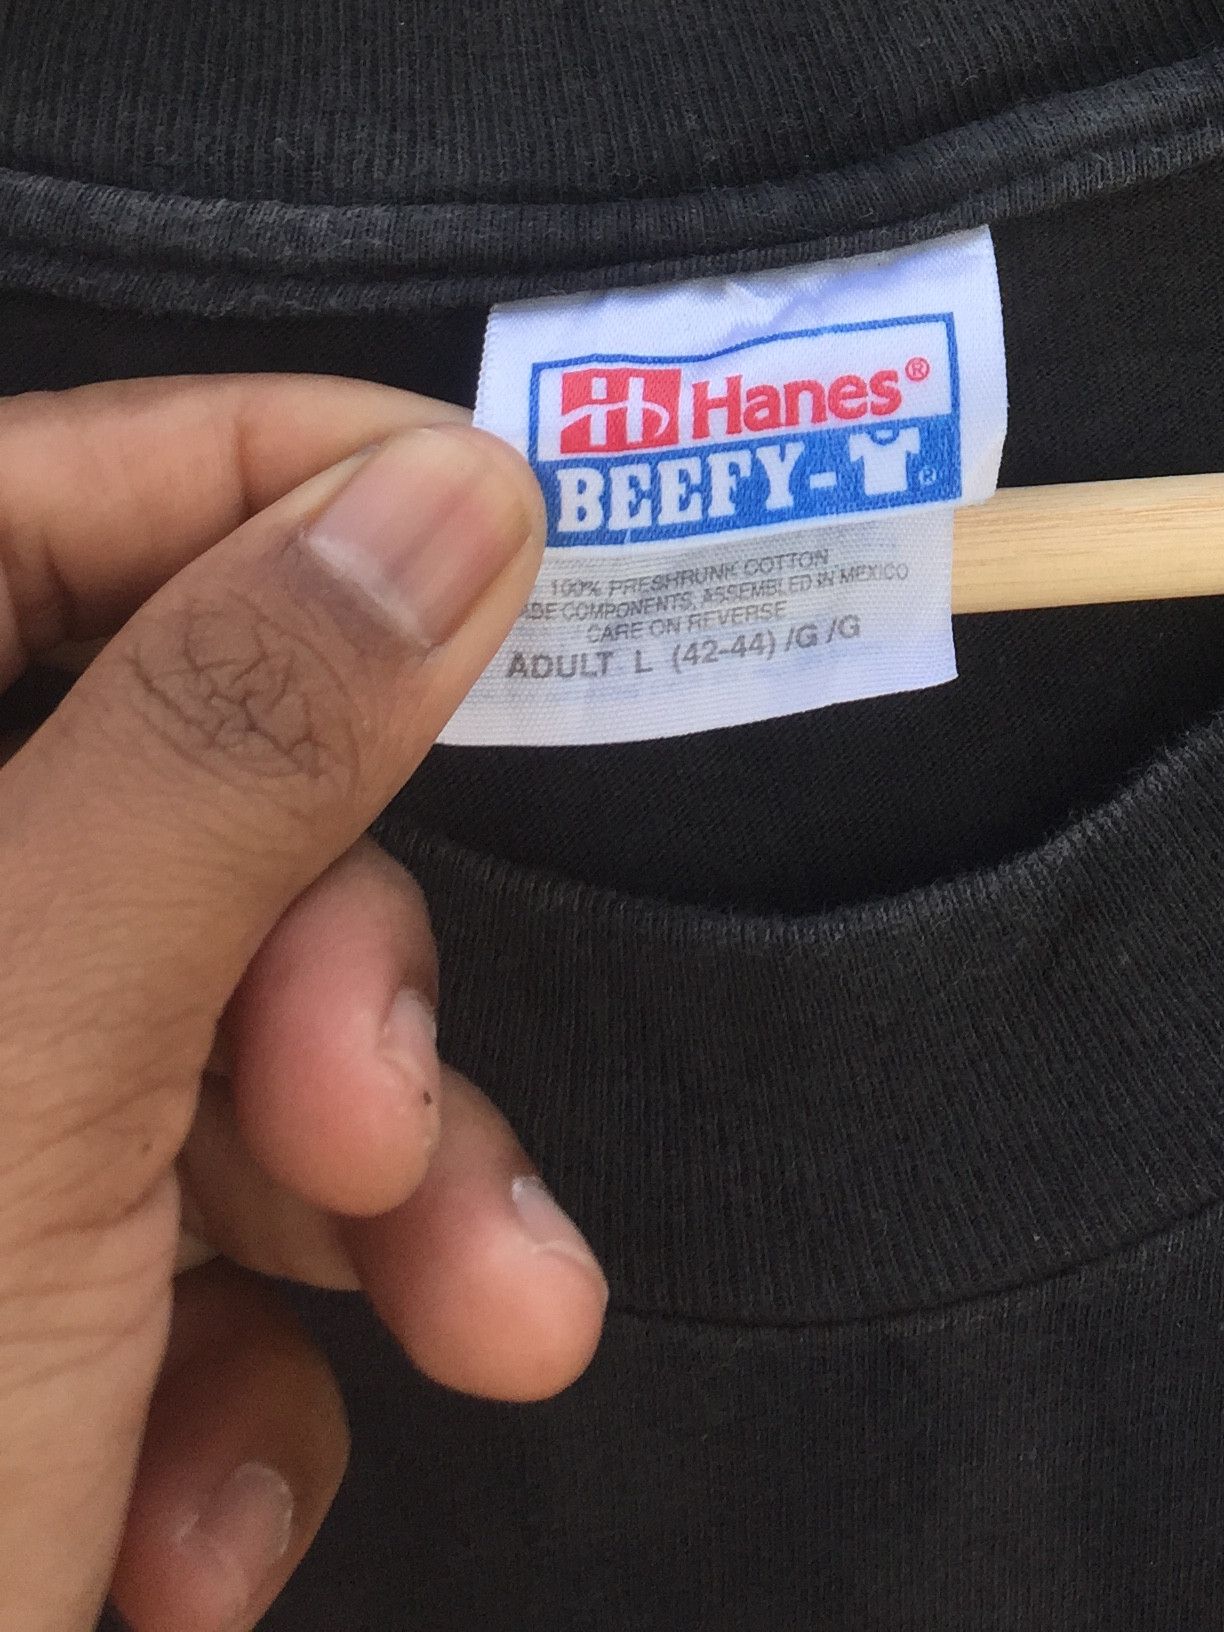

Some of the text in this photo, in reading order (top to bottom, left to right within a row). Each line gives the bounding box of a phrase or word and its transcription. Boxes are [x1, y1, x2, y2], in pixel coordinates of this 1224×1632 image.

[551, 548, 829, 598] 100% PRESHRUNK COTTON
[703, 573, 812, 604] ASSEMBLED
[817, 567, 834, 587] IN
[839, 562, 909, 585] MEXICO
[586, 600, 787, 643] CARE ON REVERSE
[505, 650, 614, 679] ADULT
[634, 649, 653, 673] L
[672, 629, 776, 674] (42-44)
